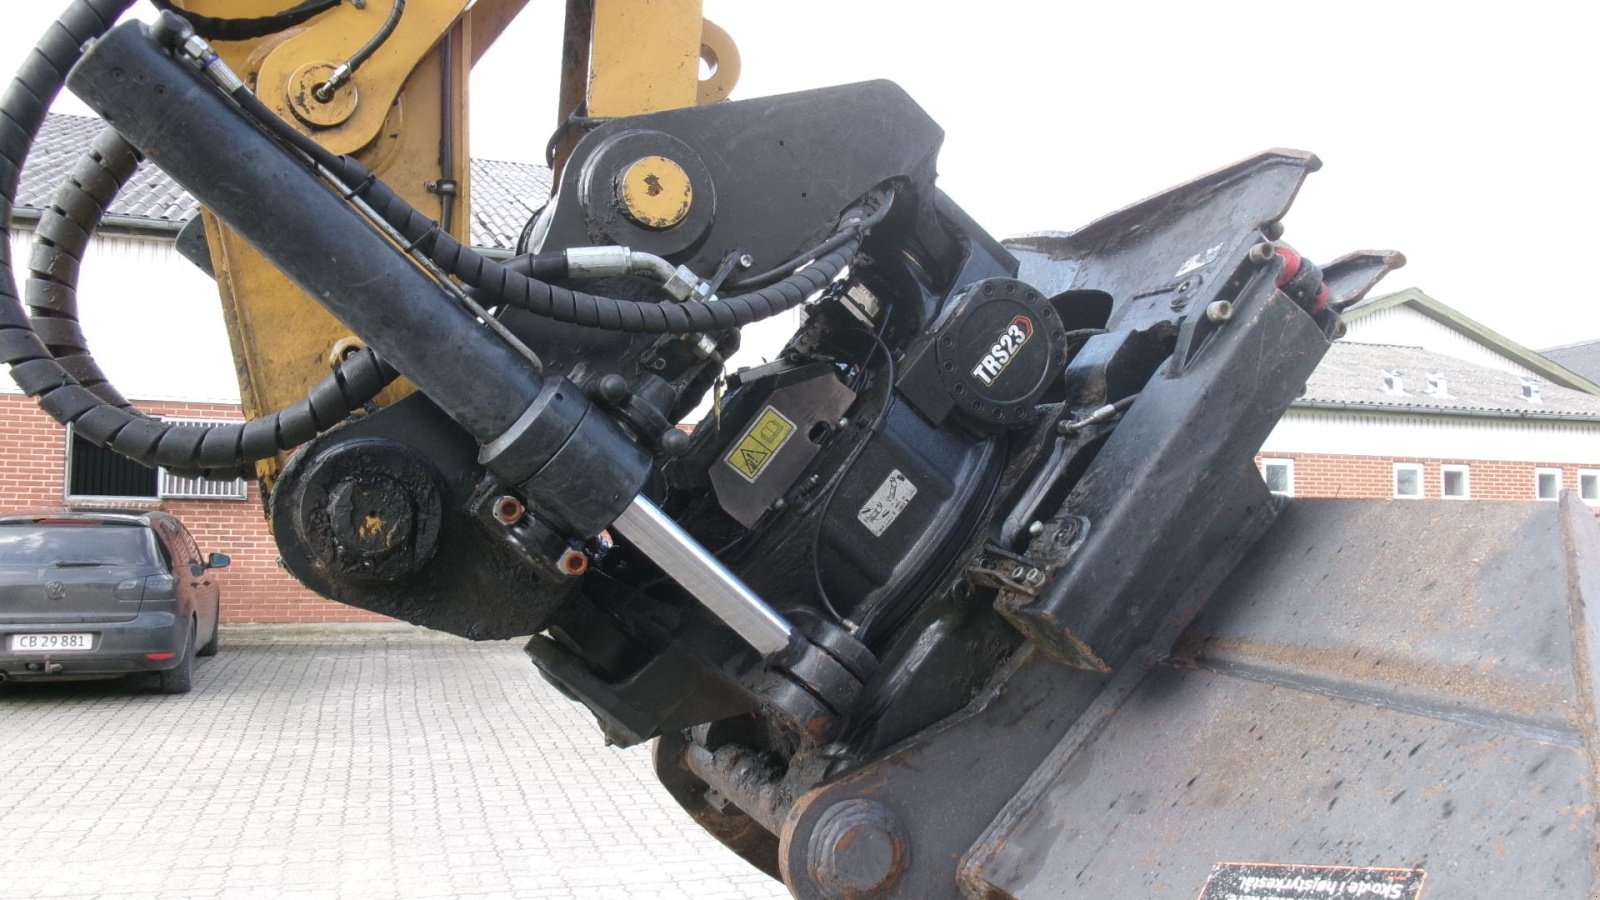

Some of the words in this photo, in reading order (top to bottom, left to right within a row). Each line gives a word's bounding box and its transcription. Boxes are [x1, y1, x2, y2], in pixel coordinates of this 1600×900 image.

[973, 325, 1026, 384] TRS23
[20, 636, 37, 647] CB
[41, 636, 58, 647] 29
[61, 635, 84, 647] 881
